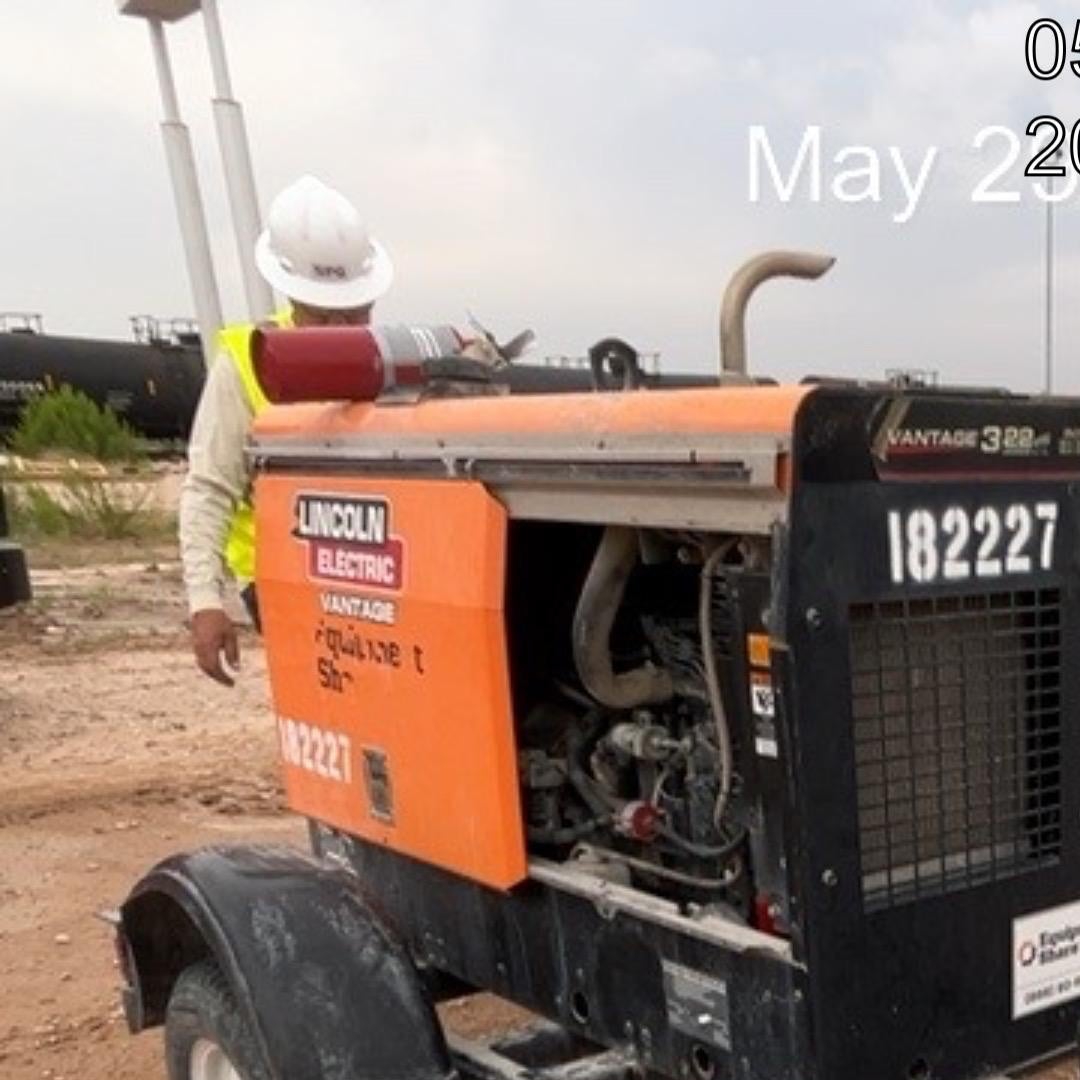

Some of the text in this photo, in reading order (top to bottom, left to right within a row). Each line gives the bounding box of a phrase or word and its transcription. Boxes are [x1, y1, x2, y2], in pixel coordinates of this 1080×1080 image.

[888, 429, 979, 449] VANTAGE
[298, 500, 385, 545] LINCOLN
[888, 502, 1058, 584] 182227
[317, 547, 396, 586] ELECTRIC
[319, 593, 395, 624] VANTAGE
[278, 715, 352, 784] 182227
[1039, 943, 1079, 966] Share
